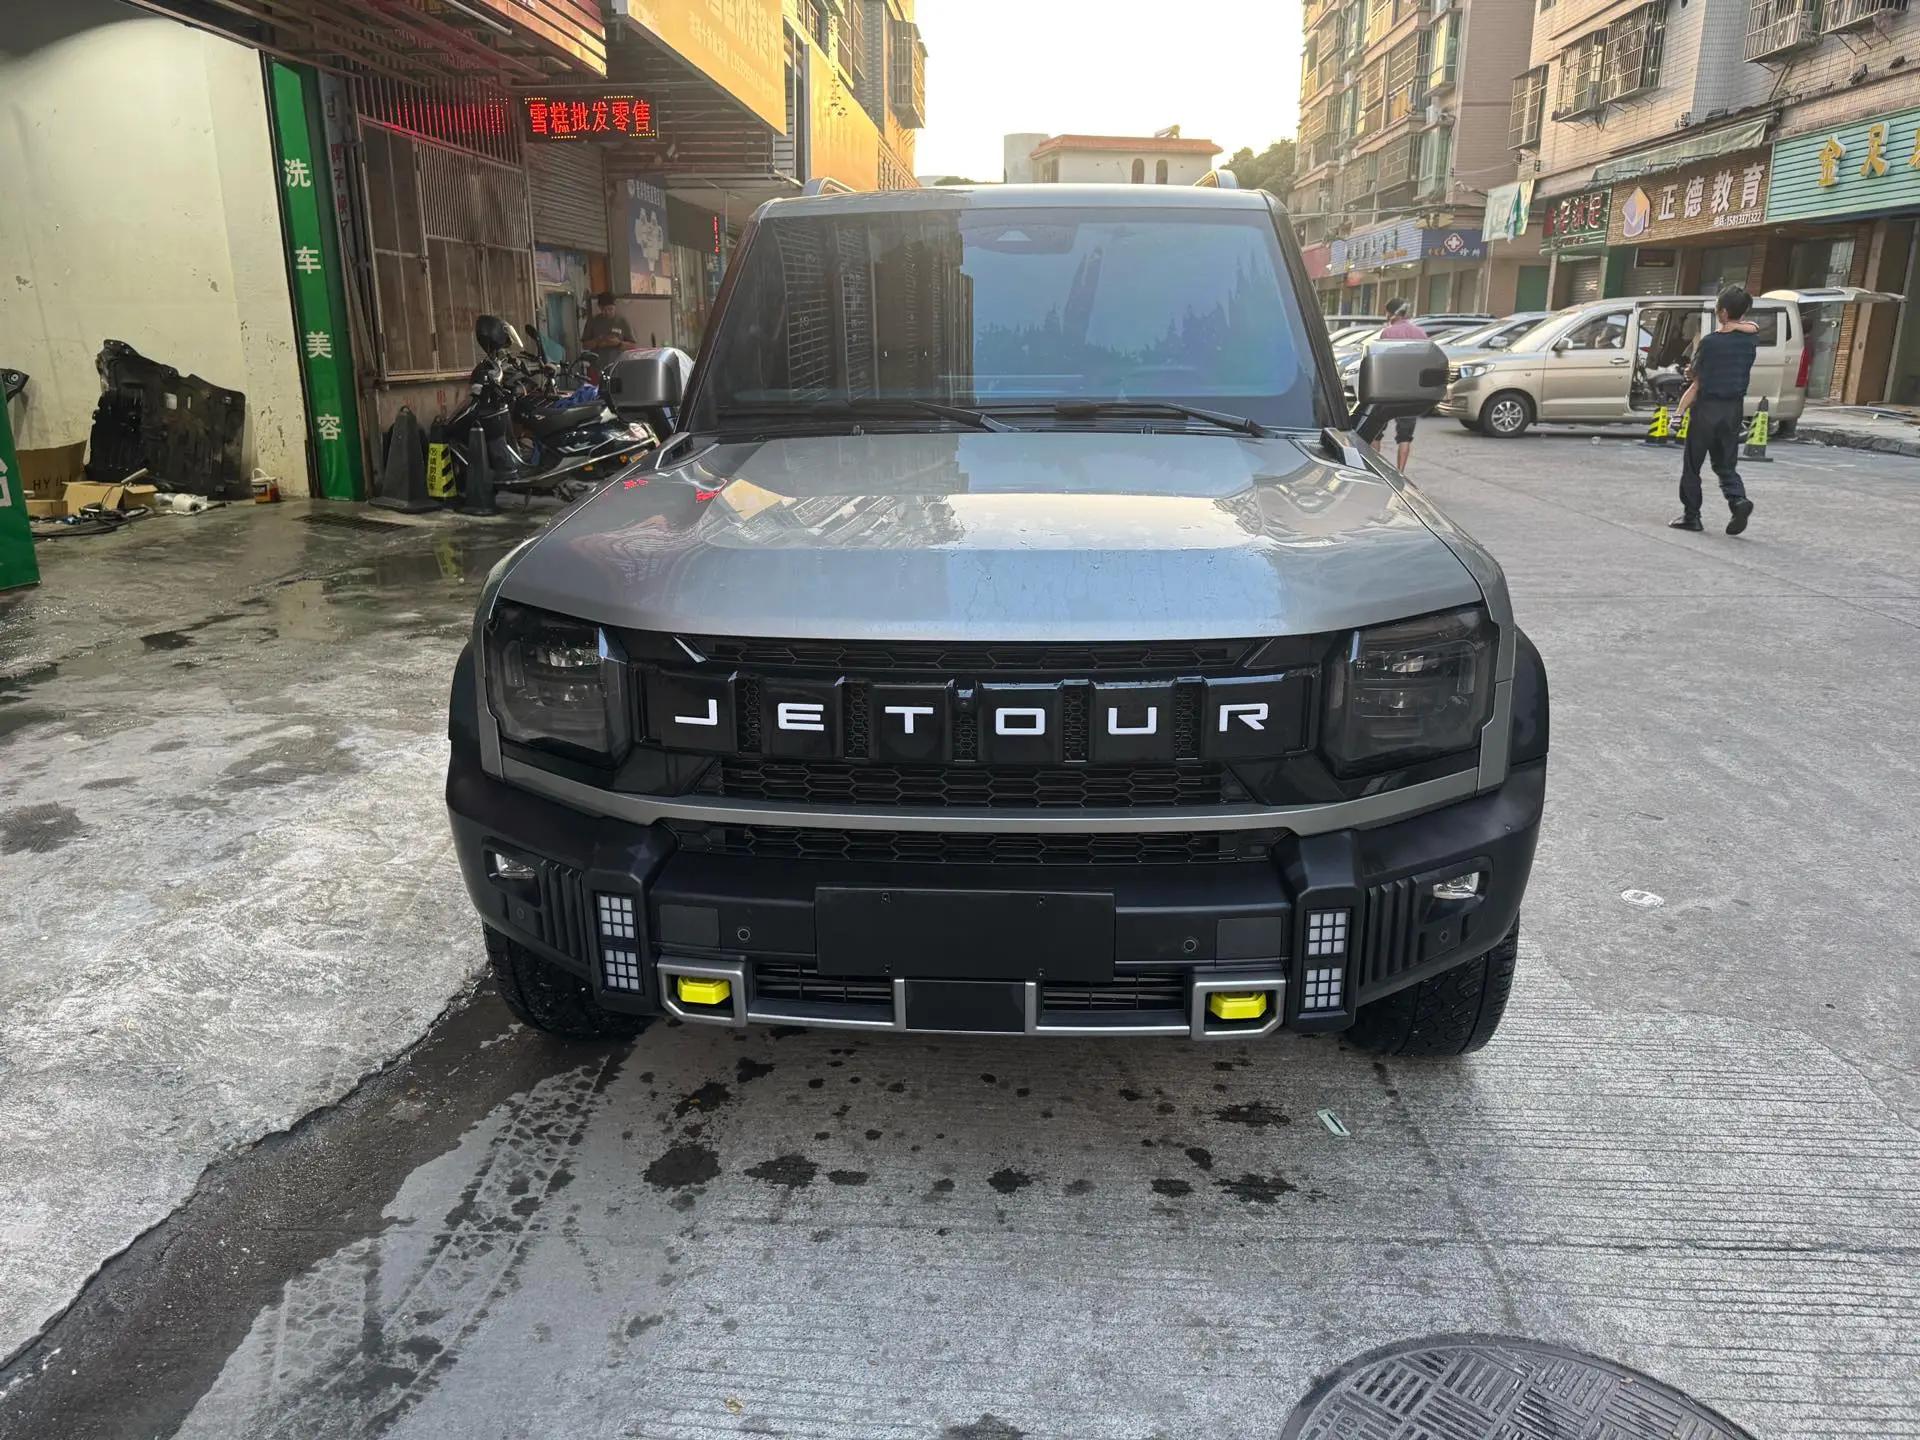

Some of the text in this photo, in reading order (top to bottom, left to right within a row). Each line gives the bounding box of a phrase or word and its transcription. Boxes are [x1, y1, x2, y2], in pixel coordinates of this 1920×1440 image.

[529, 100, 651, 135] 雪糕批发零售
[1817, 122, 1920, 187] 金足
[1658, 162, 1766, 221] 正德教育
[284, 158, 342, 441] 洗车美容
[674, 699, 1269, 735] JETOUR
